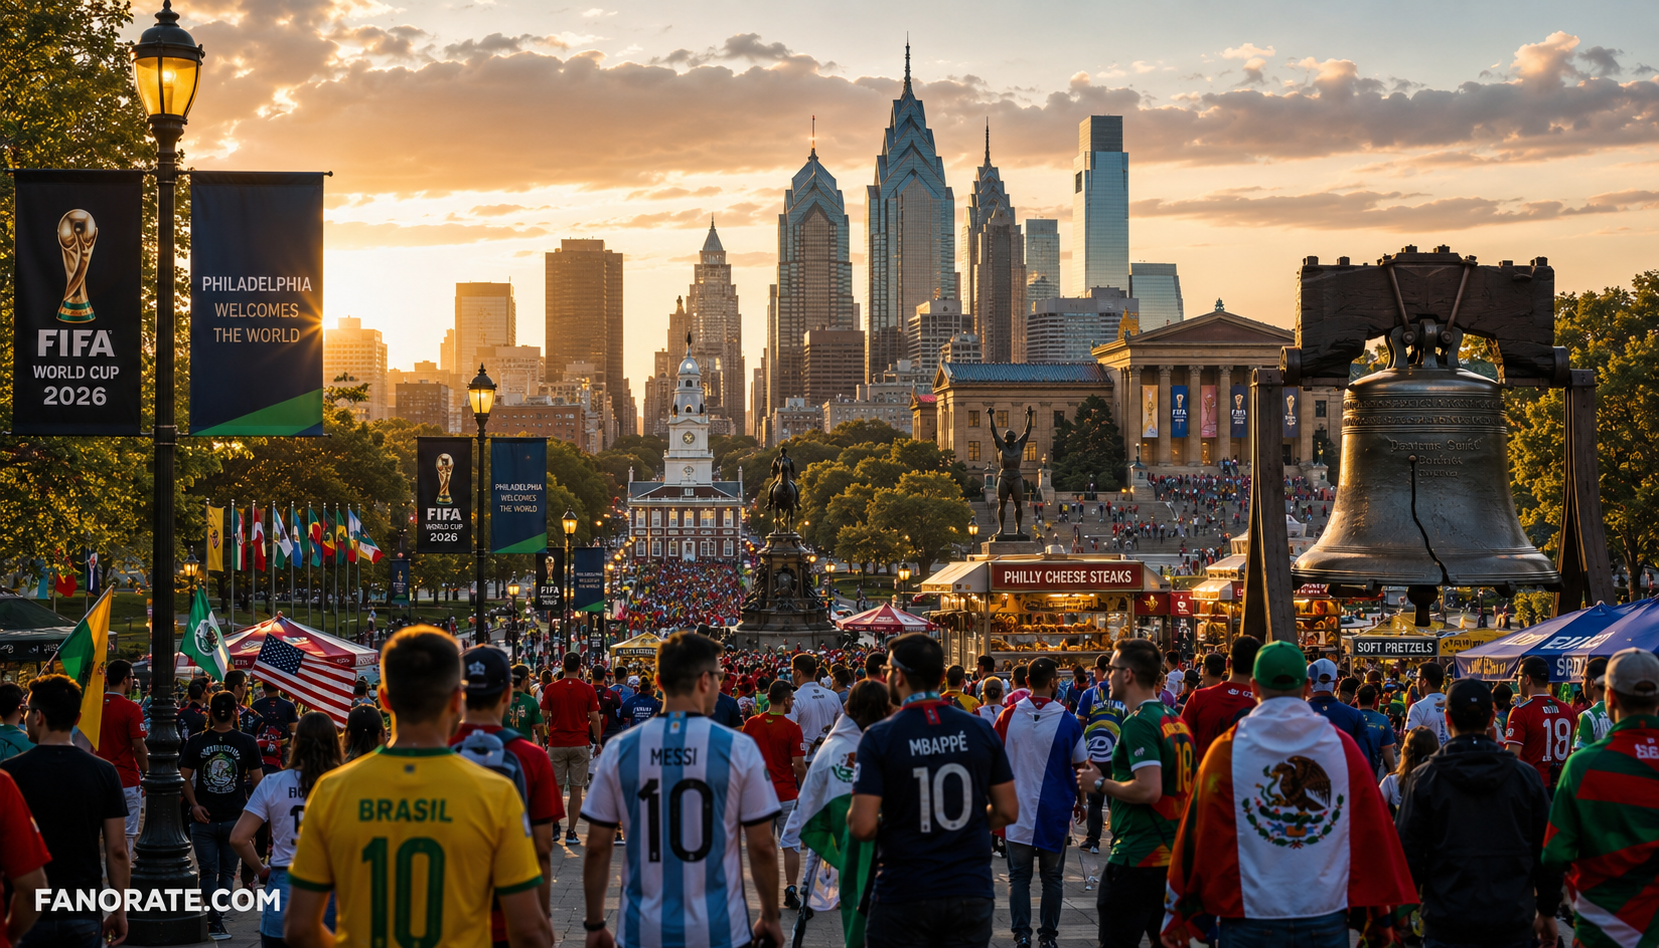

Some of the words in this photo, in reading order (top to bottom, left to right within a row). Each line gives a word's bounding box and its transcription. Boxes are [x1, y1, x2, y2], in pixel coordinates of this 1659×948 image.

[202, 276, 313, 292] PHILADELPHIA
[214, 302, 299, 318] WELCOMES
[38, 329, 115, 357] FIFA
[213, 327, 242, 343] THE
[246, 327, 300, 343] WORLD
[33, 365, 86, 379] WORLD
[89, 365, 120, 380] CUP
[43, 385, 107, 406] 2026
[494, 483, 543, 491] PHILADELPHIA
[427, 508, 462, 521] FIFA
[500, 505, 512, 513] THE
[430, 532, 458, 542] 2026
[1004, 570, 1042, 584] PHILLY
[1045, 570, 1087, 584] CHEESE
[1090, 570, 1132, 584] STEAKS
[1357, 642, 1382, 653] SOFT
[1385, 642, 1433, 653] PRETZELS
[909, 730, 968, 756] MBAPPÉ
[1542, 718, 1571, 762] 18
[650, 747, 697, 766] MESSI
[1175, 741, 1193, 794] 18
[913, 762, 973, 833] 10
[358, 798, 453, 823] BRASIL
[637, 777, 714, 863] 10
[362, 836, 446, 948] 10
